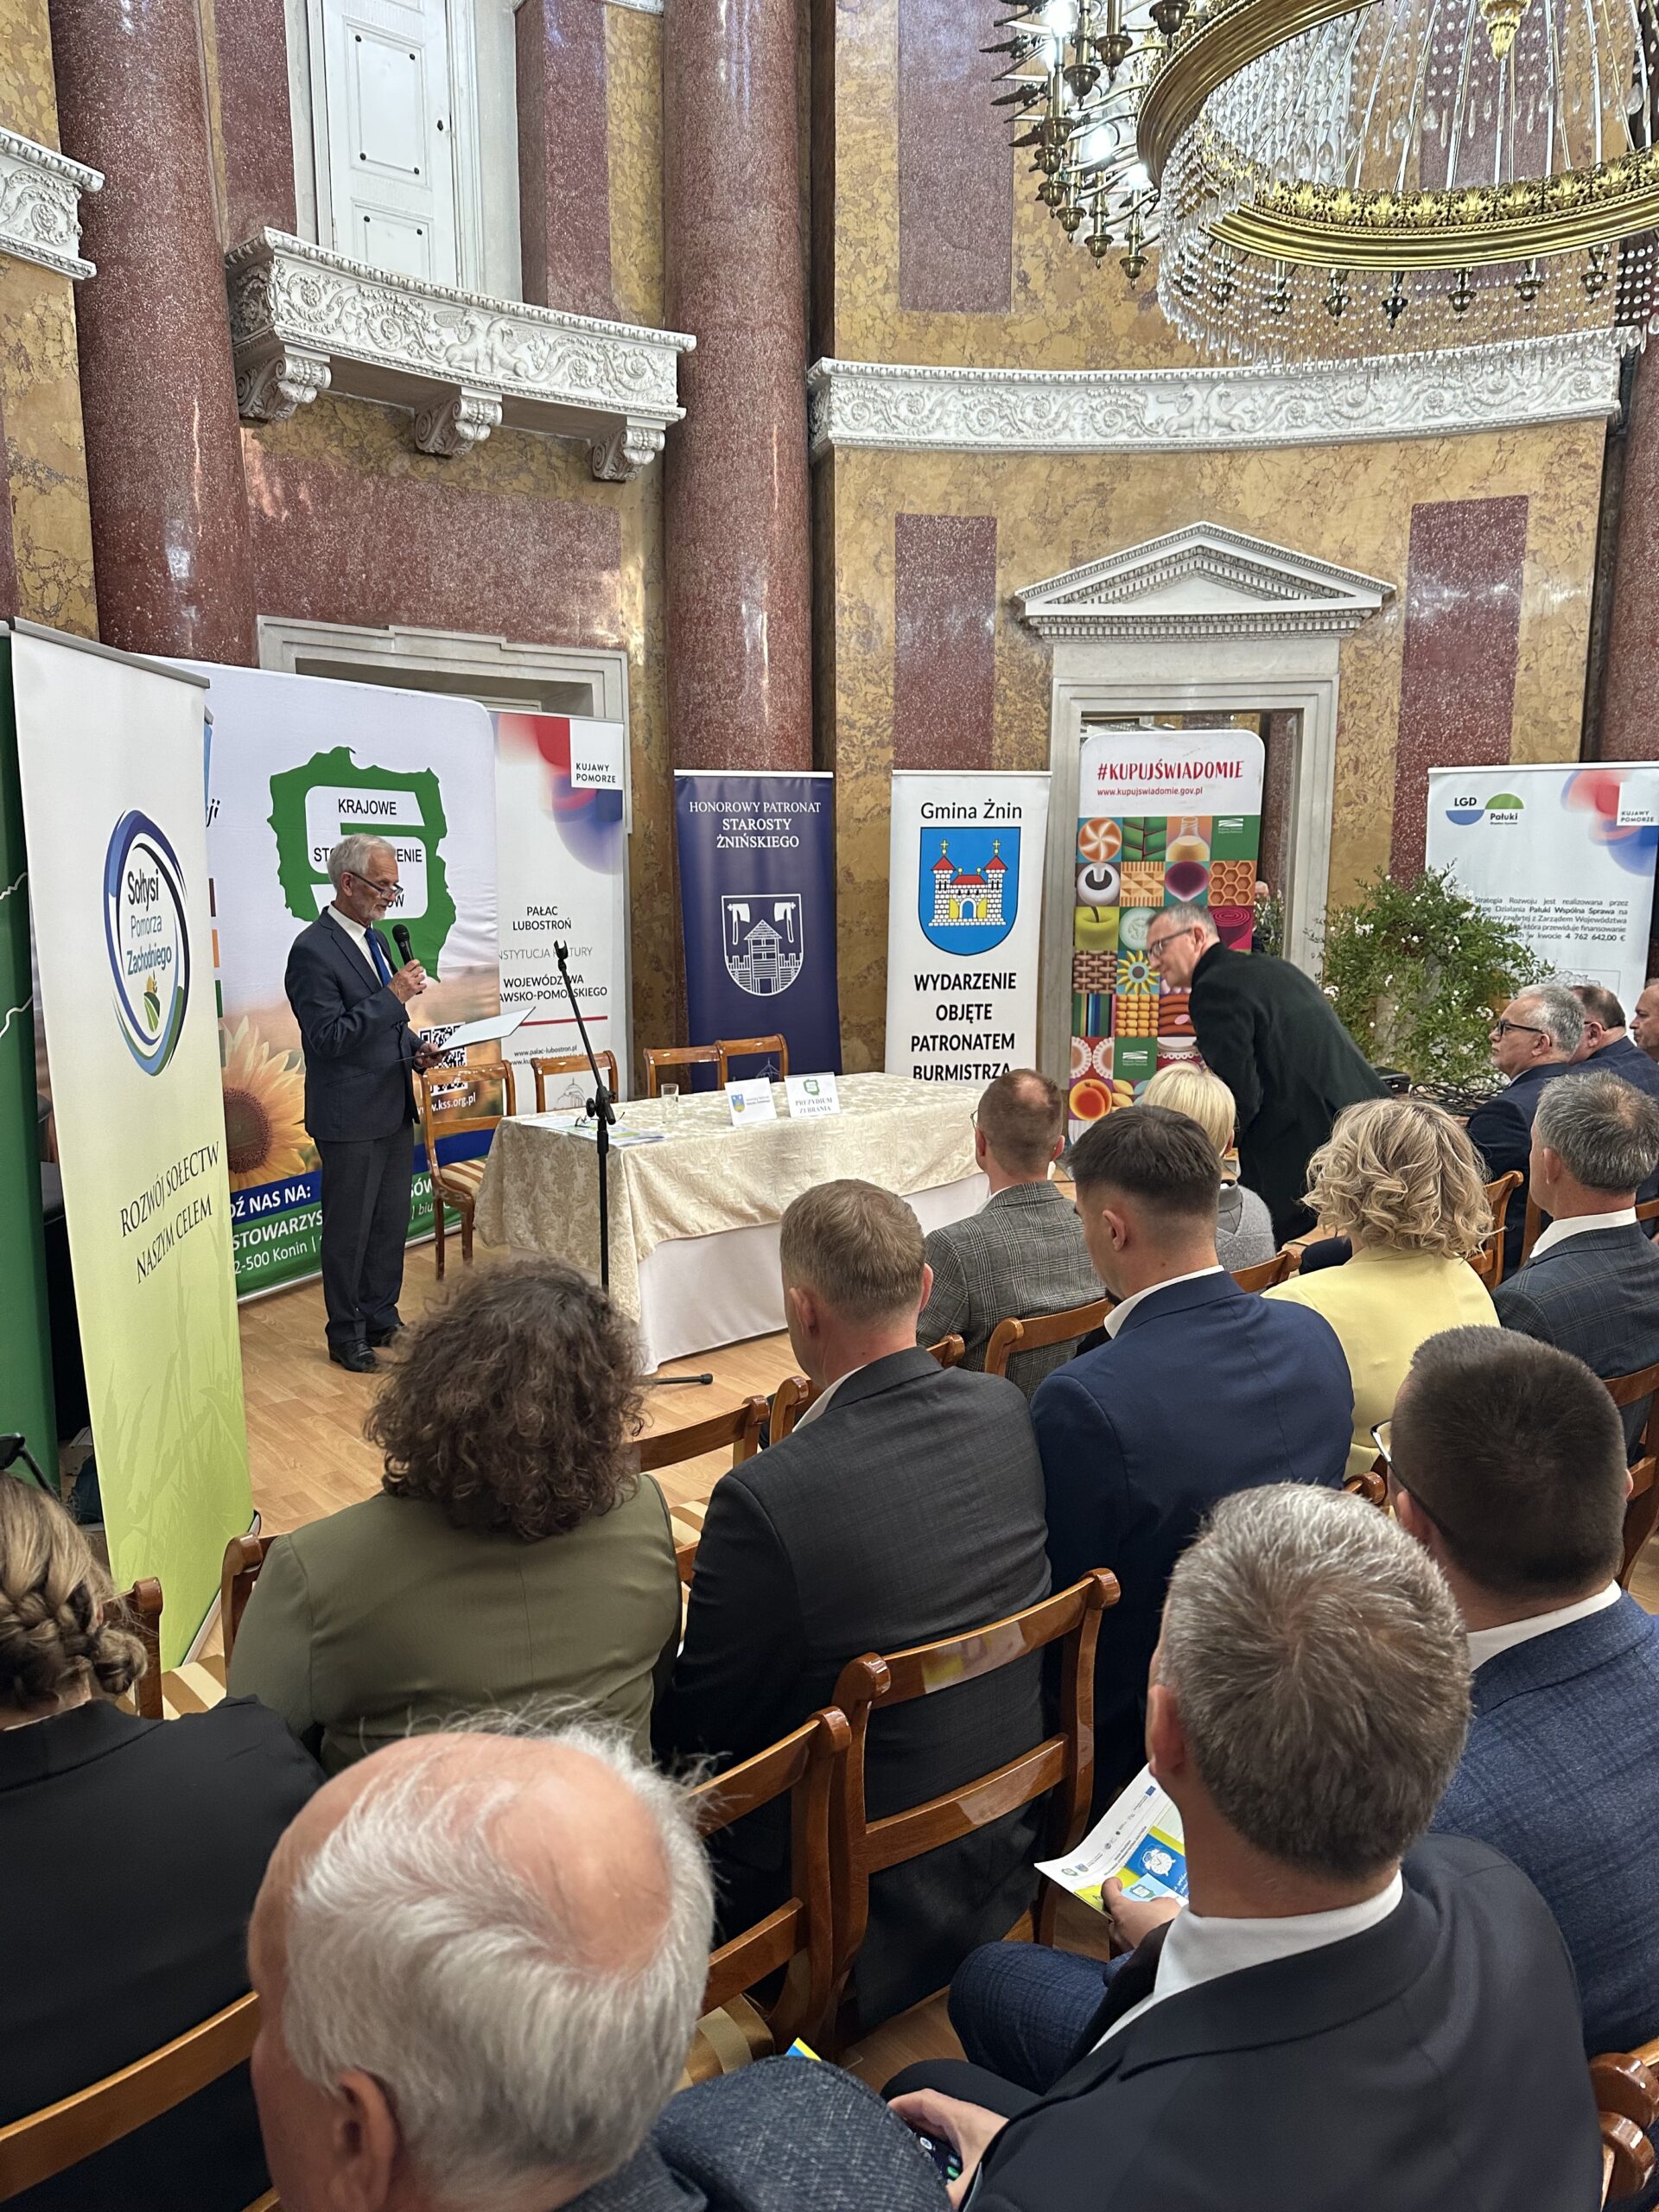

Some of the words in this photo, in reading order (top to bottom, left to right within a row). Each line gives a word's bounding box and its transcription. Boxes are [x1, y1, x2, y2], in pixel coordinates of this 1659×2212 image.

[575, 762, 609, 772] KUJAWY
[1097, 759, 1244, 781] #KUPUJŚWIADOMIE
[576, 773, 616, 783] POMORZE
[1096, 786, 1204, 797] www.kupujswiadomie.gov.pl
[338, 798, 397, 816] KRAJOWE
[690, 801, 760, 813] HONOROWY
[763, 802, 822, 813] PATRONAT
[921, 802, 977, 819] Gmina
[982, 798, 1022, 819] Żnin
[1454, 797, 1477, 806] LGD
[722, 818, 792, 830] STAROSTY
[716, 833, 799, 849] ŻNIŃSKIEGO
[127, 868, 159, 912] Sołtysi
[1475, 896, 1503, 905] Strategia
[1509, 897, 1537, 906] Rozwoju
[526, 906, 558, 916] PAŁAC
[130, 915, 162, 938] Pomorza
[512, 917, 571, 931] LUBOSTROŃ
[126, 942, 172, 976] Zachodniego
[504, 974, 584, 988] WOJEWÓDZWA
[914, 972, 1016, 991] WYDARZENIE
[936, 1003, 992, 1024] OBJĘTE
[911, 1033, 1015, 1052] PATRONATEM
[120, 1173, 165, 1237] ROZWÓJ
[166, 1141, 219, 1198] SOŁECTW
[249, 1191, 281, 1213] NAS
[284, 1184, 311, 1204] NA:
[137, 1222, 175, 1284] NASZYM
[176, 1193, 213, 1240] CELEM
[232, 1210, 323, 1251] STOWARZYS
[235, 1251, 270, 1274] 2-500
[272, 1242, 308, 1262] Konin
